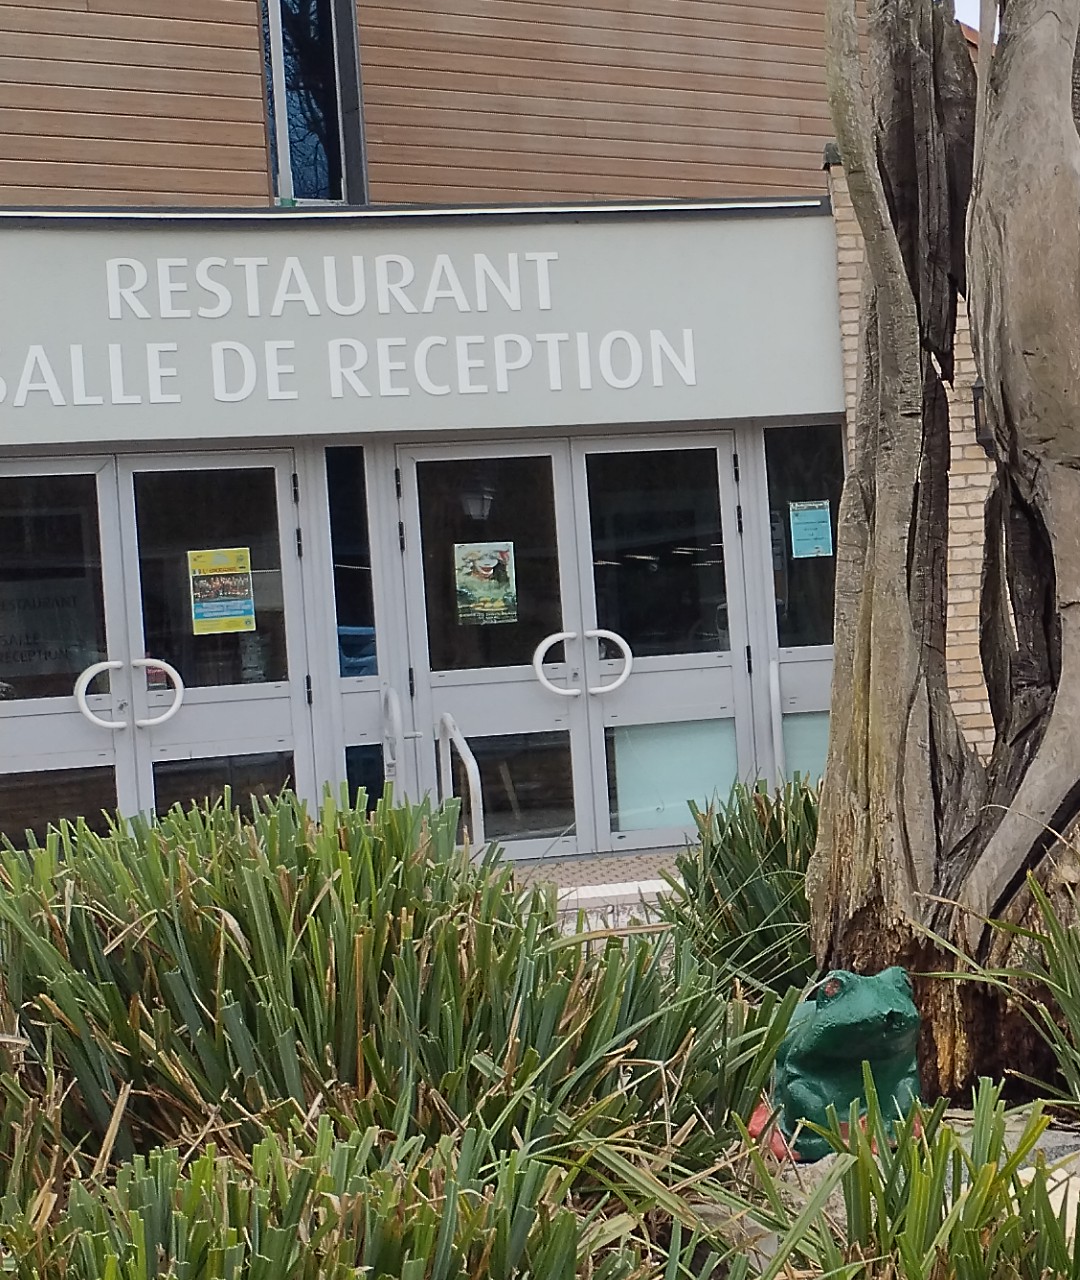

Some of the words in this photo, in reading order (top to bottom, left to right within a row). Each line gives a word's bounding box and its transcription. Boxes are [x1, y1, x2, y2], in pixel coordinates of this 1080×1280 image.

[105, 251, 559, 319] RESTAURANT
[0, 342, 182, 407] ALLE
[210, 339, 299, 402] DE
[327, 328, 697, 398] RECEPTION
